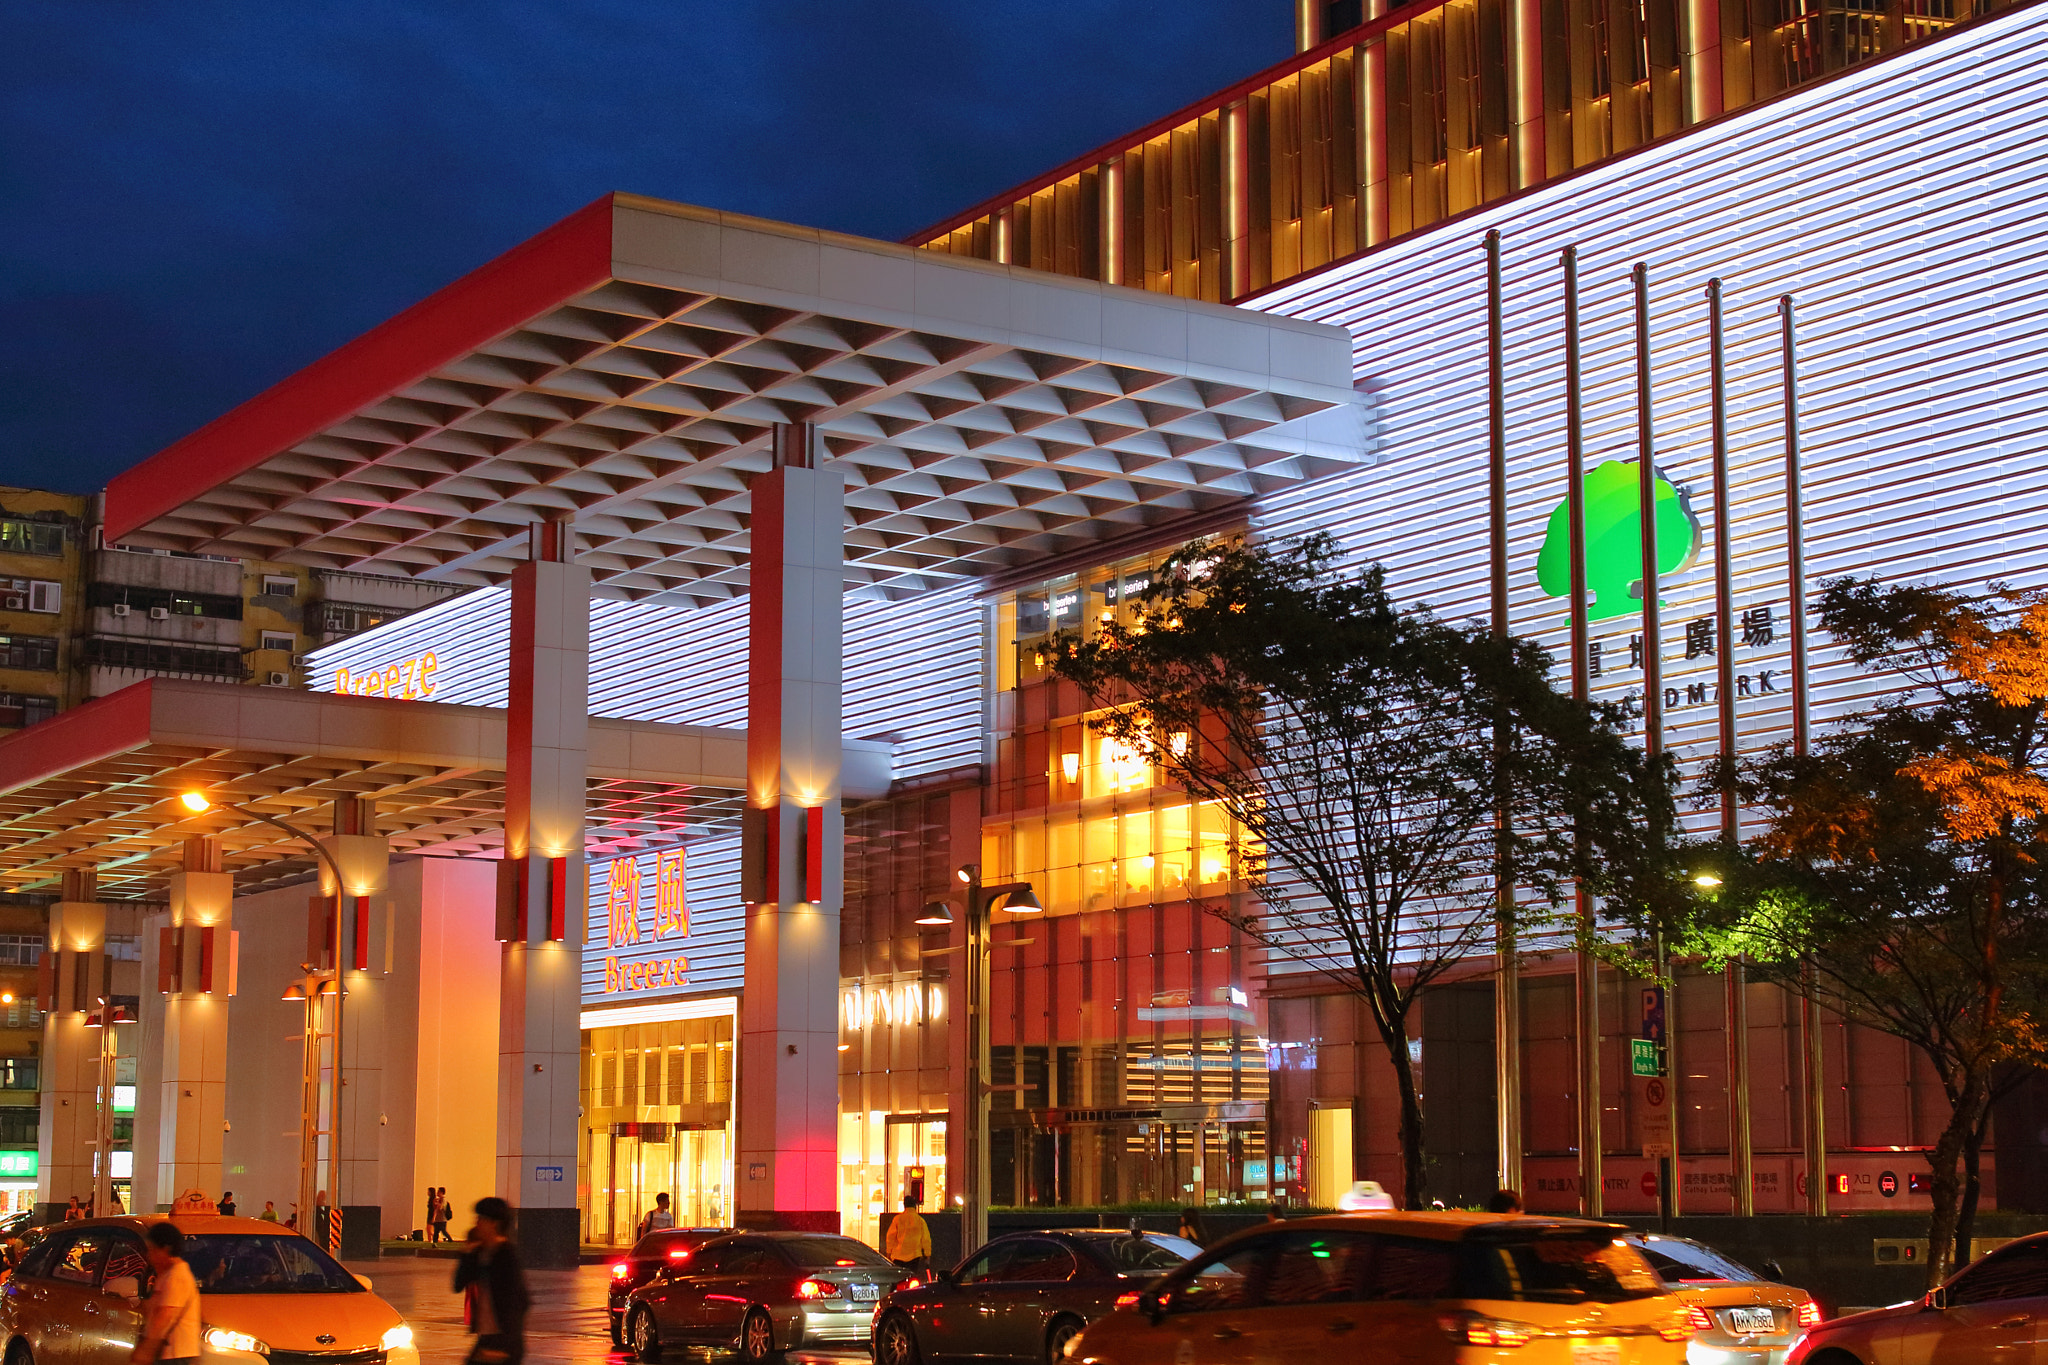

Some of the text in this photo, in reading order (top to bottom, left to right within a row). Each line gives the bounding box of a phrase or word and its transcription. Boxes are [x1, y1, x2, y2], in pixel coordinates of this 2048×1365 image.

[1108, 580, 1142, 598] brserie
[335, 651, 438, 700] Breeze
[1603, 670, 1775, 720] ADMRK
[606, 847, 692, 949] 微風
[604, 955, 690, 994] Breeze
[1643, 990, 1658, 1020] P
[1538, 1178, 1575, 1191] 禁止進入
[1603, 1179, 1630, 1190] NTRY
[1761, 1185, 1777, 1193] Park
[1853, 1174, 1871, 1185] 入口
